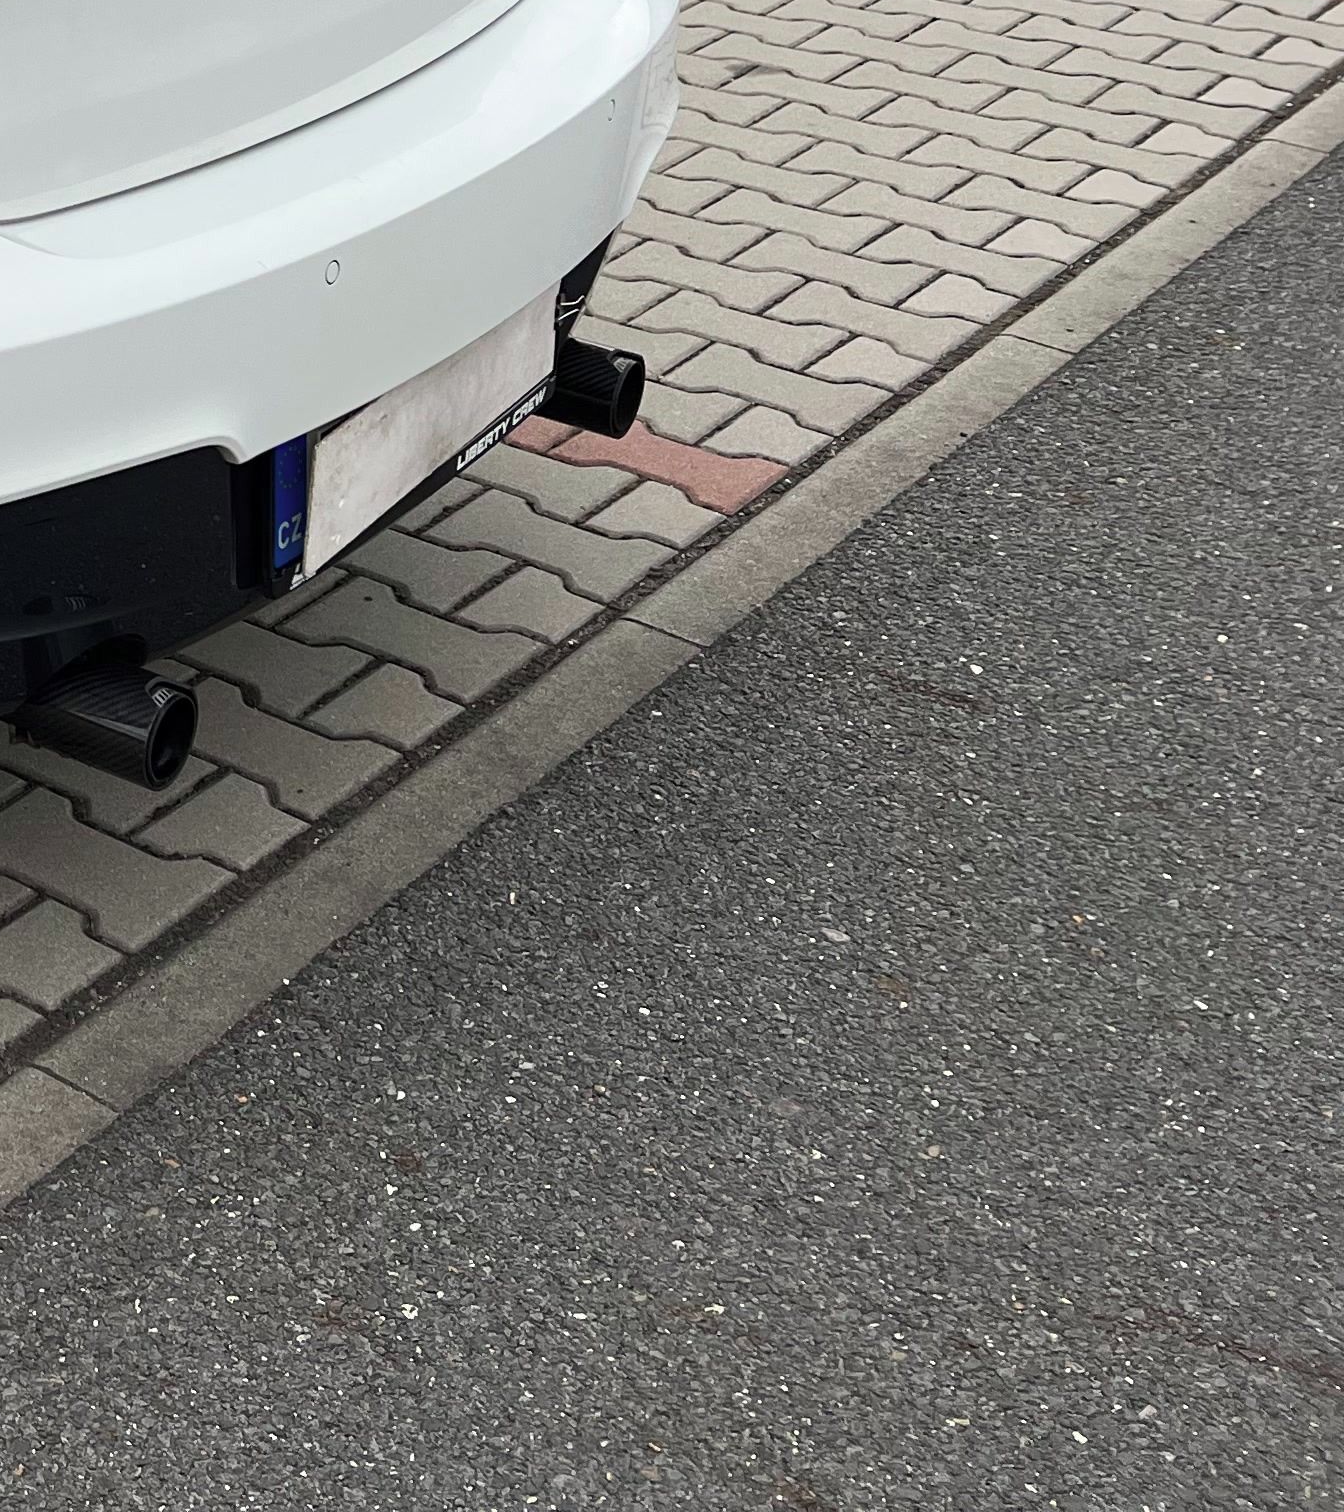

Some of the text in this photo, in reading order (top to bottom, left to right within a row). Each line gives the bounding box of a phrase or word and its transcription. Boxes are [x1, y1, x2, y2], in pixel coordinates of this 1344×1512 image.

[456, 386, 547, 471] LIBERTY CREW
[277, 513, 303, 550] CZ
